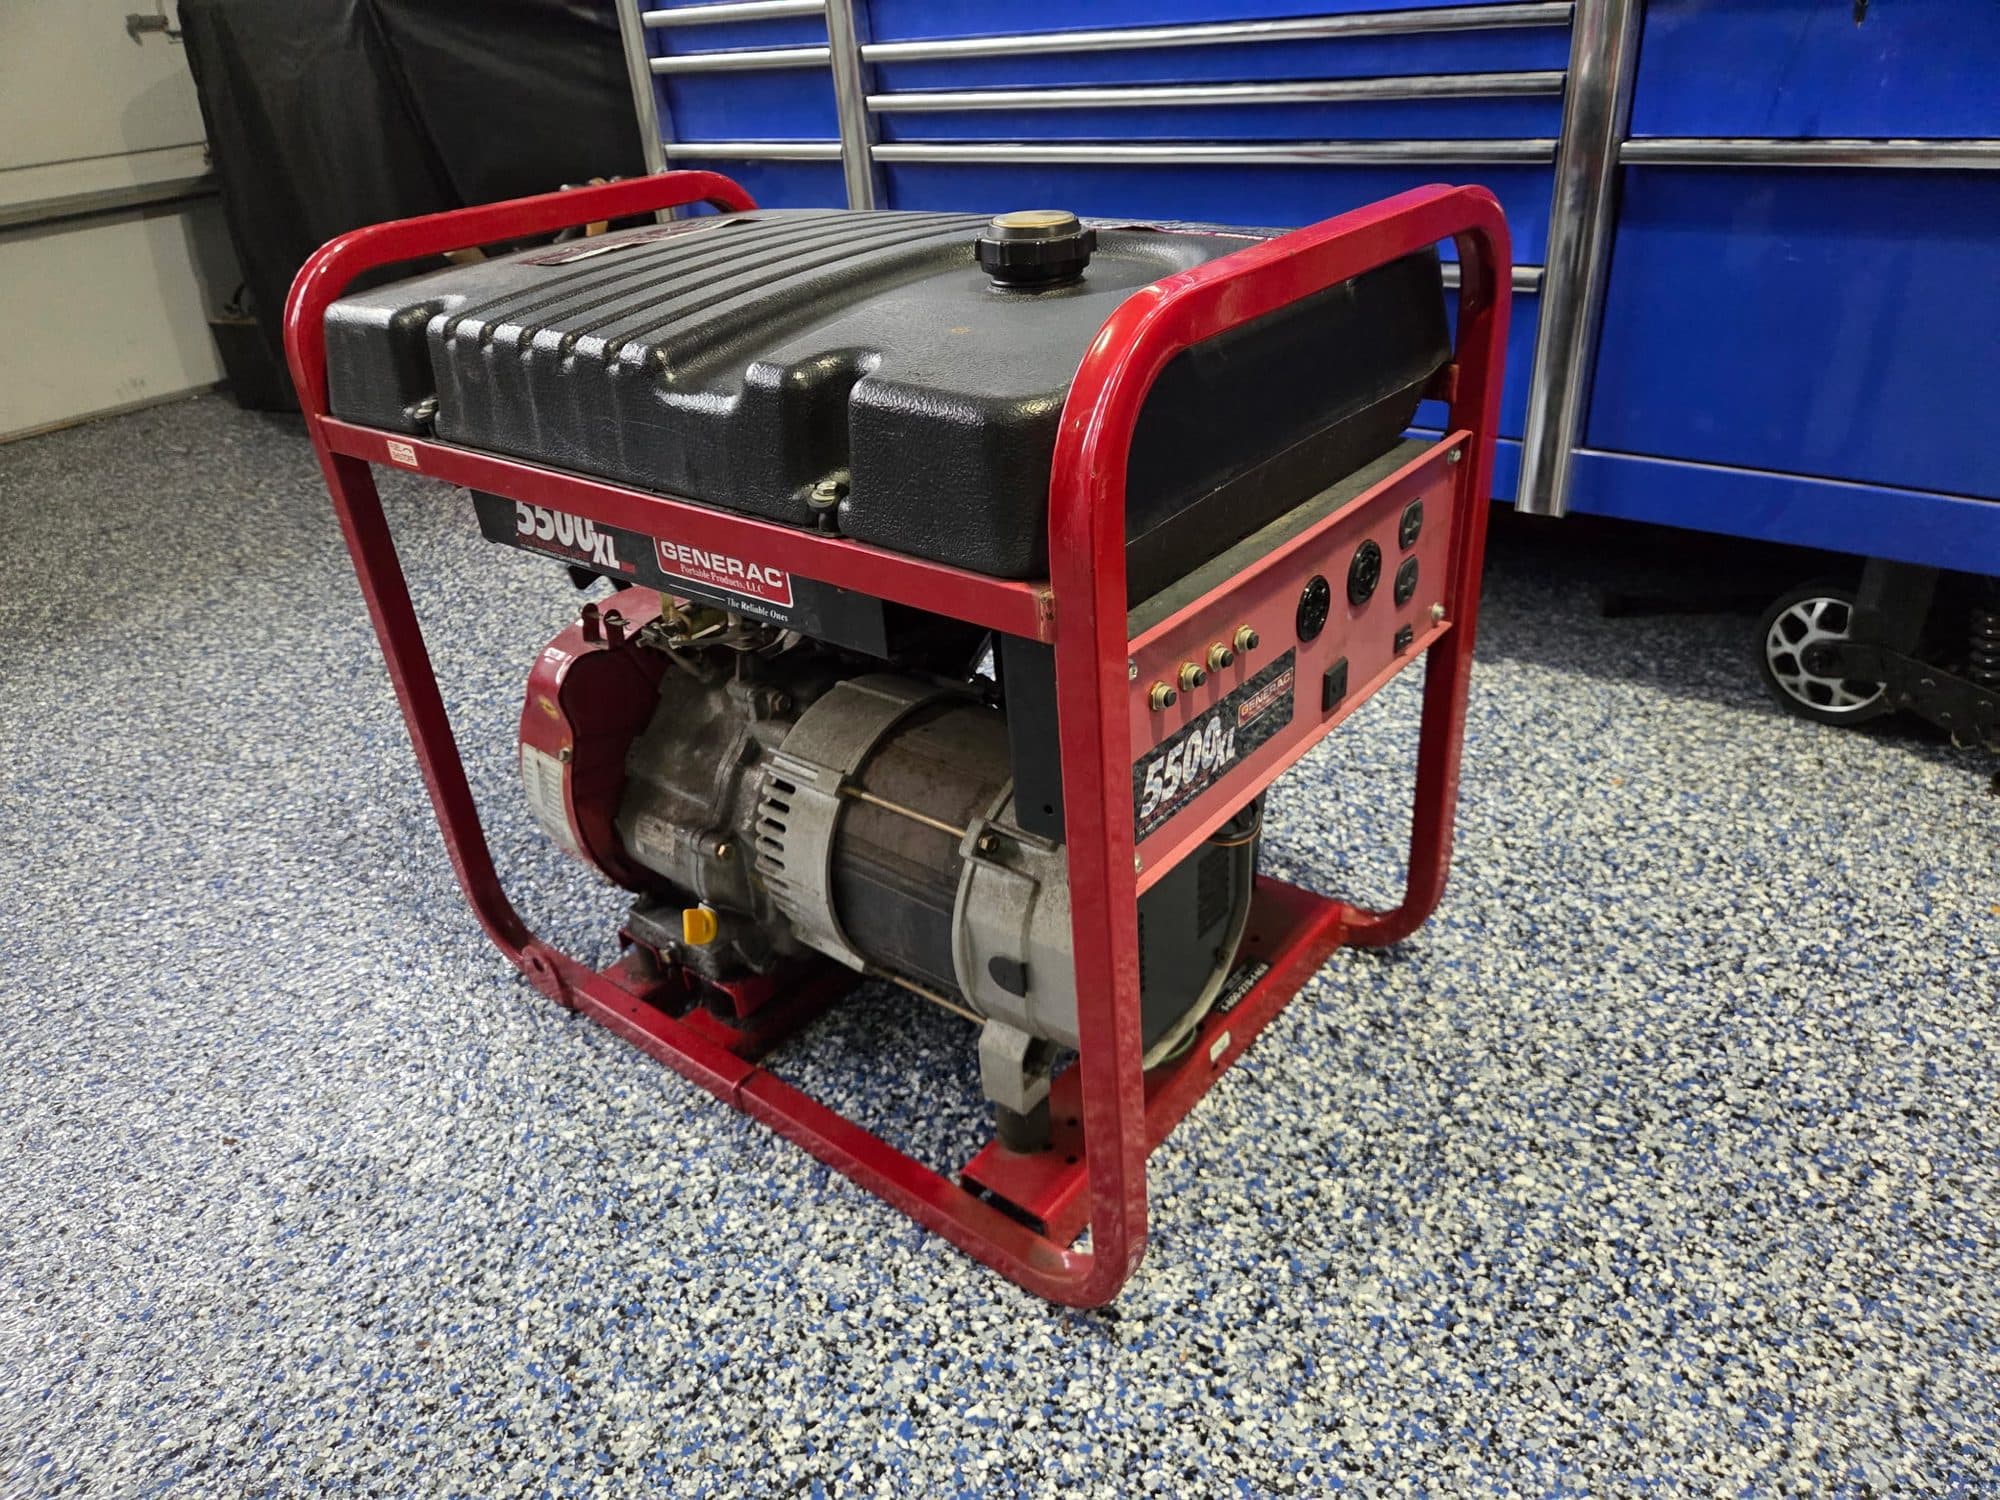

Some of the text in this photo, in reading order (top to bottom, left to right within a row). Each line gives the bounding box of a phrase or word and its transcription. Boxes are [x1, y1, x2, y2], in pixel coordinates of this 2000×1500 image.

[660, 540, 784, 588] GENERAC
[680, 563, 710, 580] Portable
[746, 581, 764, 594] LLC
[727, 597, 788, 622] The Reliable Ones
[1241, 672, 1291, 716] GENERAC
